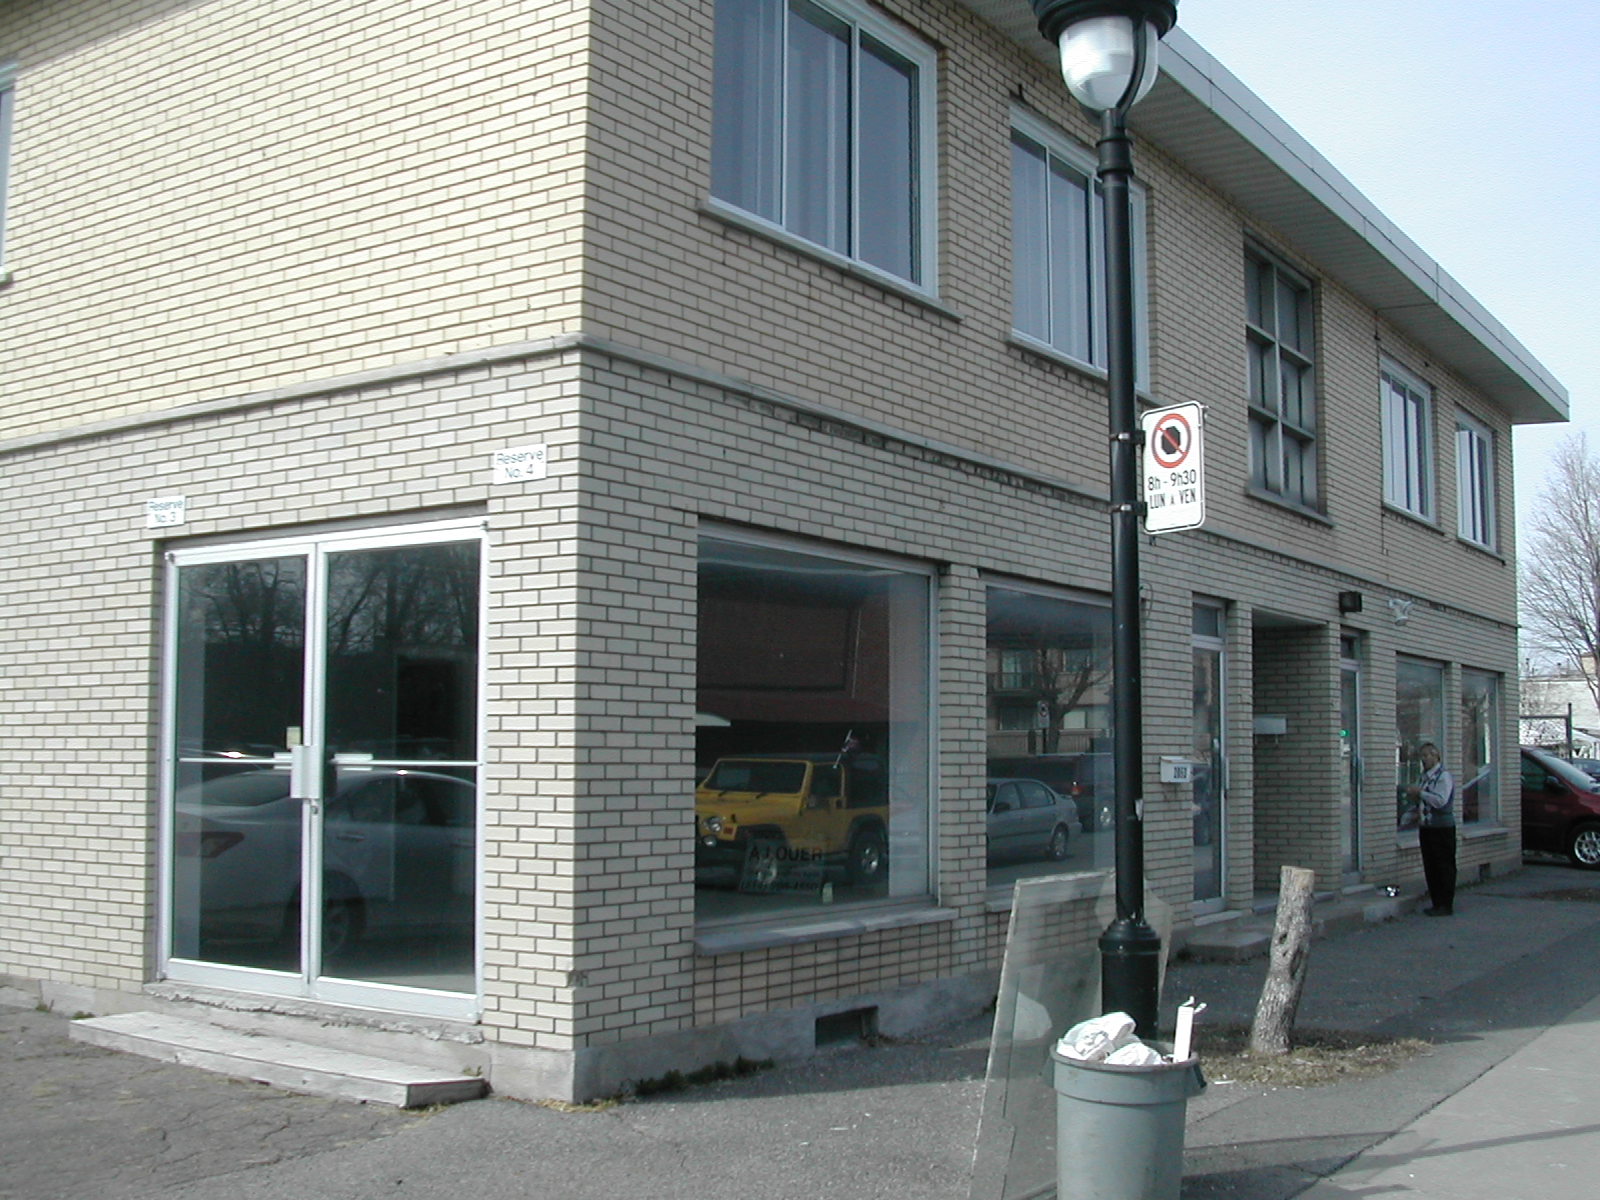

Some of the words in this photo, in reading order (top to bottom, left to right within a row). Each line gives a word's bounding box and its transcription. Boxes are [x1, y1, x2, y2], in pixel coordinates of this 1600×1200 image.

[497, 450, 544, 465] Reserve
[1147, 476, 1161, 491] 8h
[1170, 468, 1197, 487] 9h30
[1149, 492, 1166, 509] LUN
[1178, 487, 1196, 505] VEN
